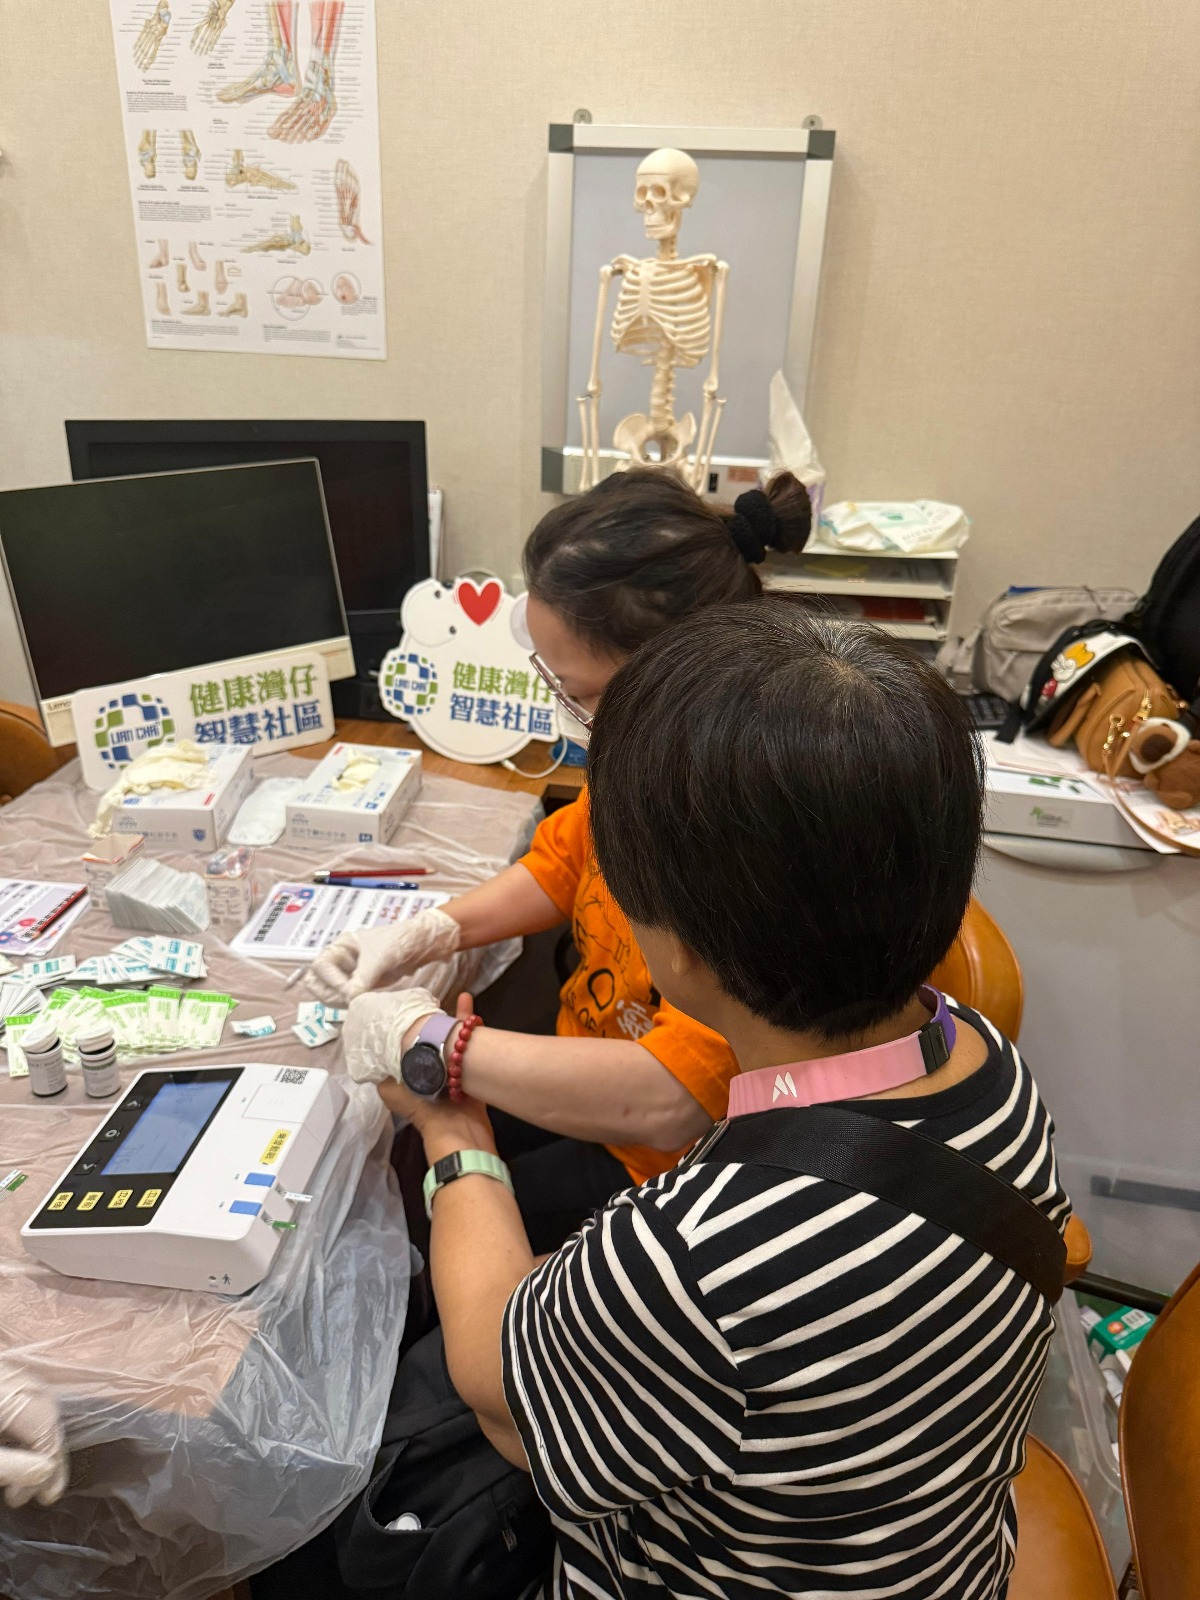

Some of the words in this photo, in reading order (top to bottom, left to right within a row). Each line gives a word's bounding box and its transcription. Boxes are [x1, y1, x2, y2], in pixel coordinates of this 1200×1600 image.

[189, 663, 318, 718] 健康灣仔
[195, 699, 324, 745] 智慧社區
[450, 693, 554, 736] 智慧社區
